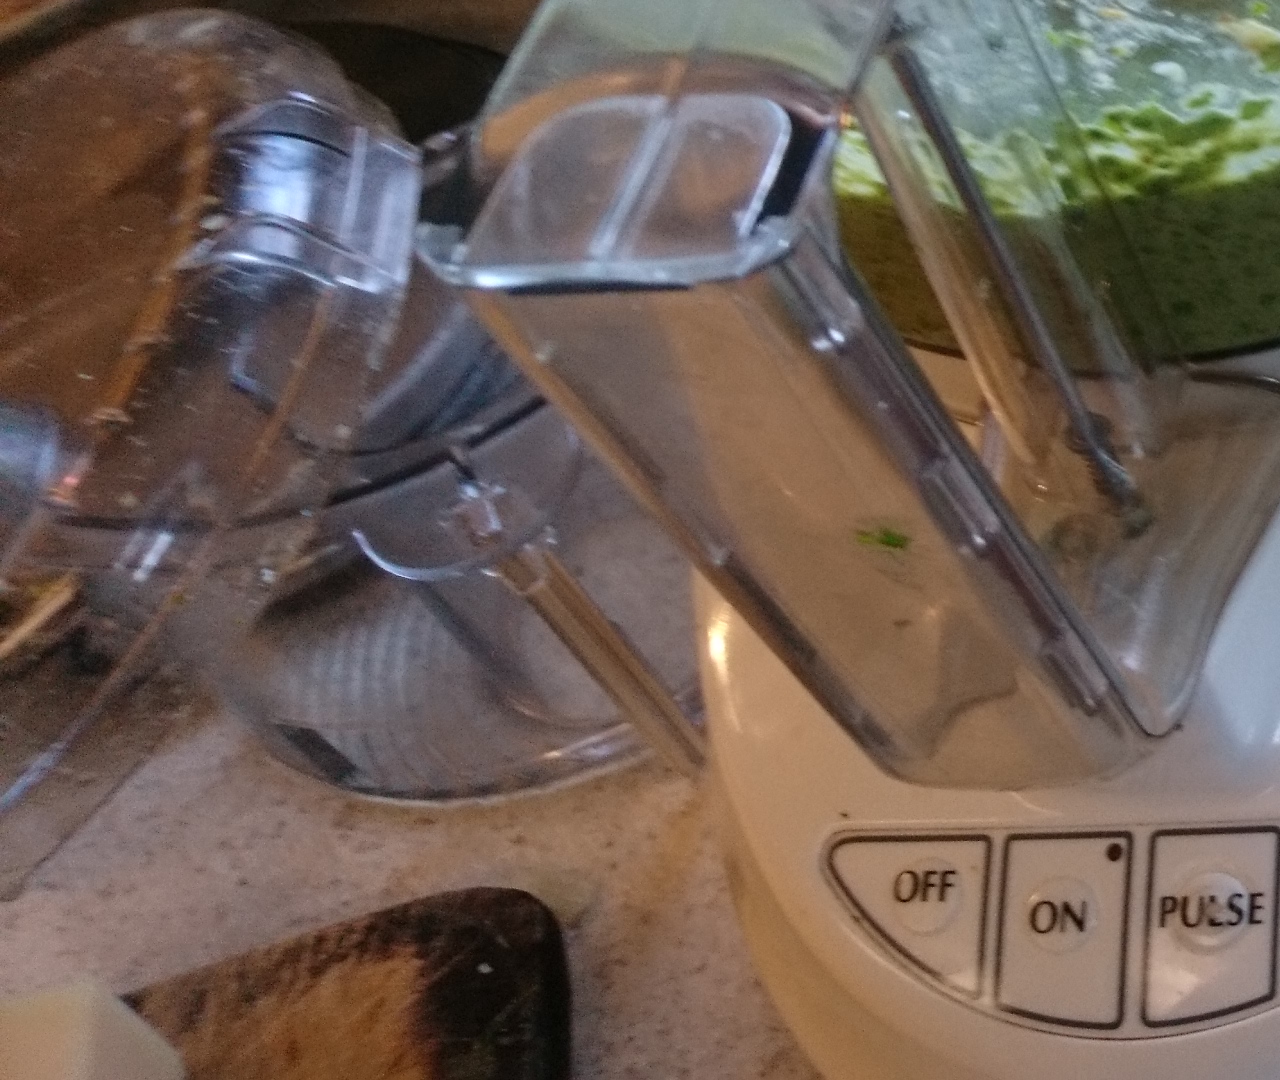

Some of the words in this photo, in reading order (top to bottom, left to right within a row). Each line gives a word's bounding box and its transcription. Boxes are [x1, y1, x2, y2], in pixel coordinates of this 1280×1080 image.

[893, 869, 958, 905] OFF
[1029, 899, 1087, 935] ON
[1157, 892, 1266, 930] PULSE
